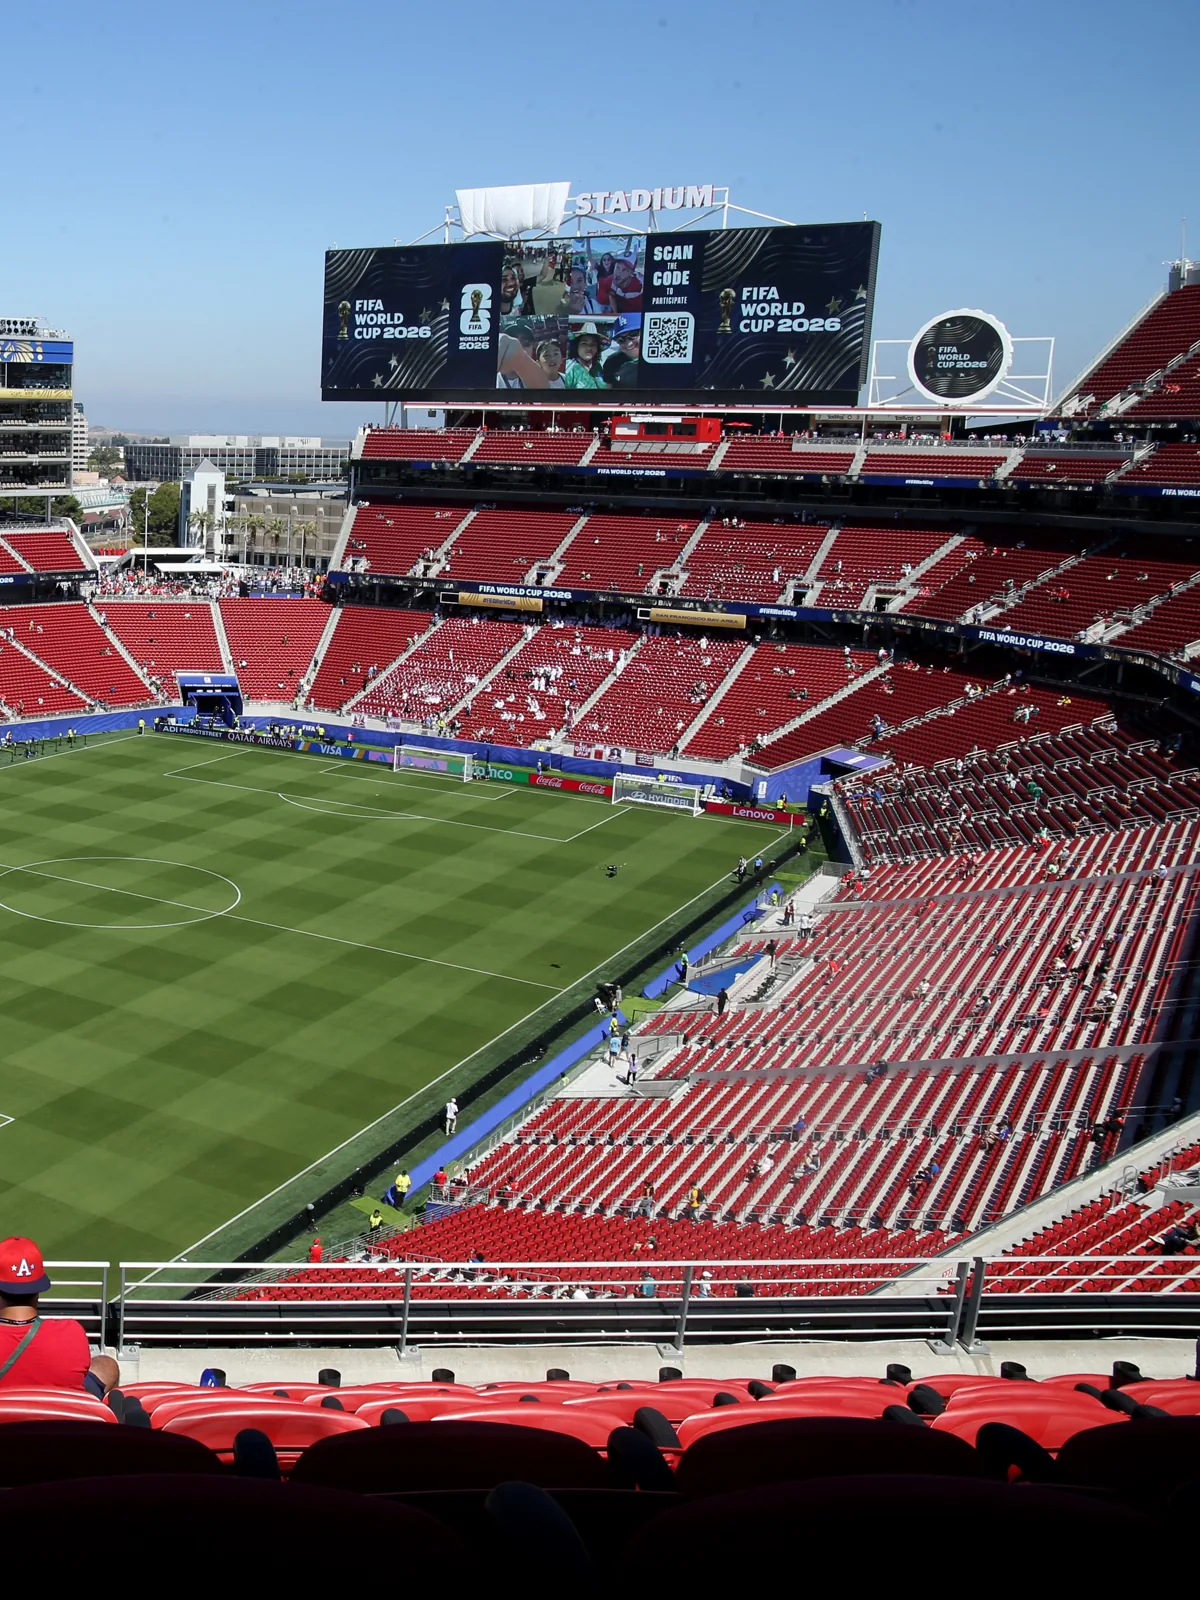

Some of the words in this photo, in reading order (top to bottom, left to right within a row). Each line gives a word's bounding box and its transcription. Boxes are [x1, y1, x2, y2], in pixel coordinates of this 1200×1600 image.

[575, 184, 714, 216] STADIUM
[653, 244, 694, 261] SCAN
[667, 262, 677, 270] THE
[652, 270, 690, 286] CODE
[666, 287, 674, 295] TO
[742, 286, 780, 301] FIFA
[355, 299, 384, 312] FIFA
[652, 296, 688, 305] PARTICIPATE
[740, 302, 806, 317] WORLD
[354, 313, 404, 326] WORLD
[739, 319, 775, 333] CUP
[777, 317, 842, 332] 2026
[354, 327, 381, 340] CUP
[382, 326, 432, 339] 2026
[458, 342, 490, 350] 2026
[478, 585, 496, 593] FIFA
[496, 586, 525, 595] WORLD
[526, 588, 542, 597] CUP
[542, 590, 572, 599] 2026
[978, 630, 996, 641] FIFA
[996, 633, 1026, 646] WORLD
[1026, 638, 1043, 649] CUP
[1043, 641, 1075, 654] 2026
[162, 725, 179, 733] ADI
[179, 727, 223, 738] PREDICTSTREET
[302, 724, 316, 732] FIFA
[227, 732, 255, 743] QATAR
[257, 736, 293, 748] AIRWAYS
[320, 744, 342, 756] VISA
[648, 794, 689, 806] HYUNDAI
[732, 806, 775, 820] Lenovo
[16, 1258, 32, 1277] A
